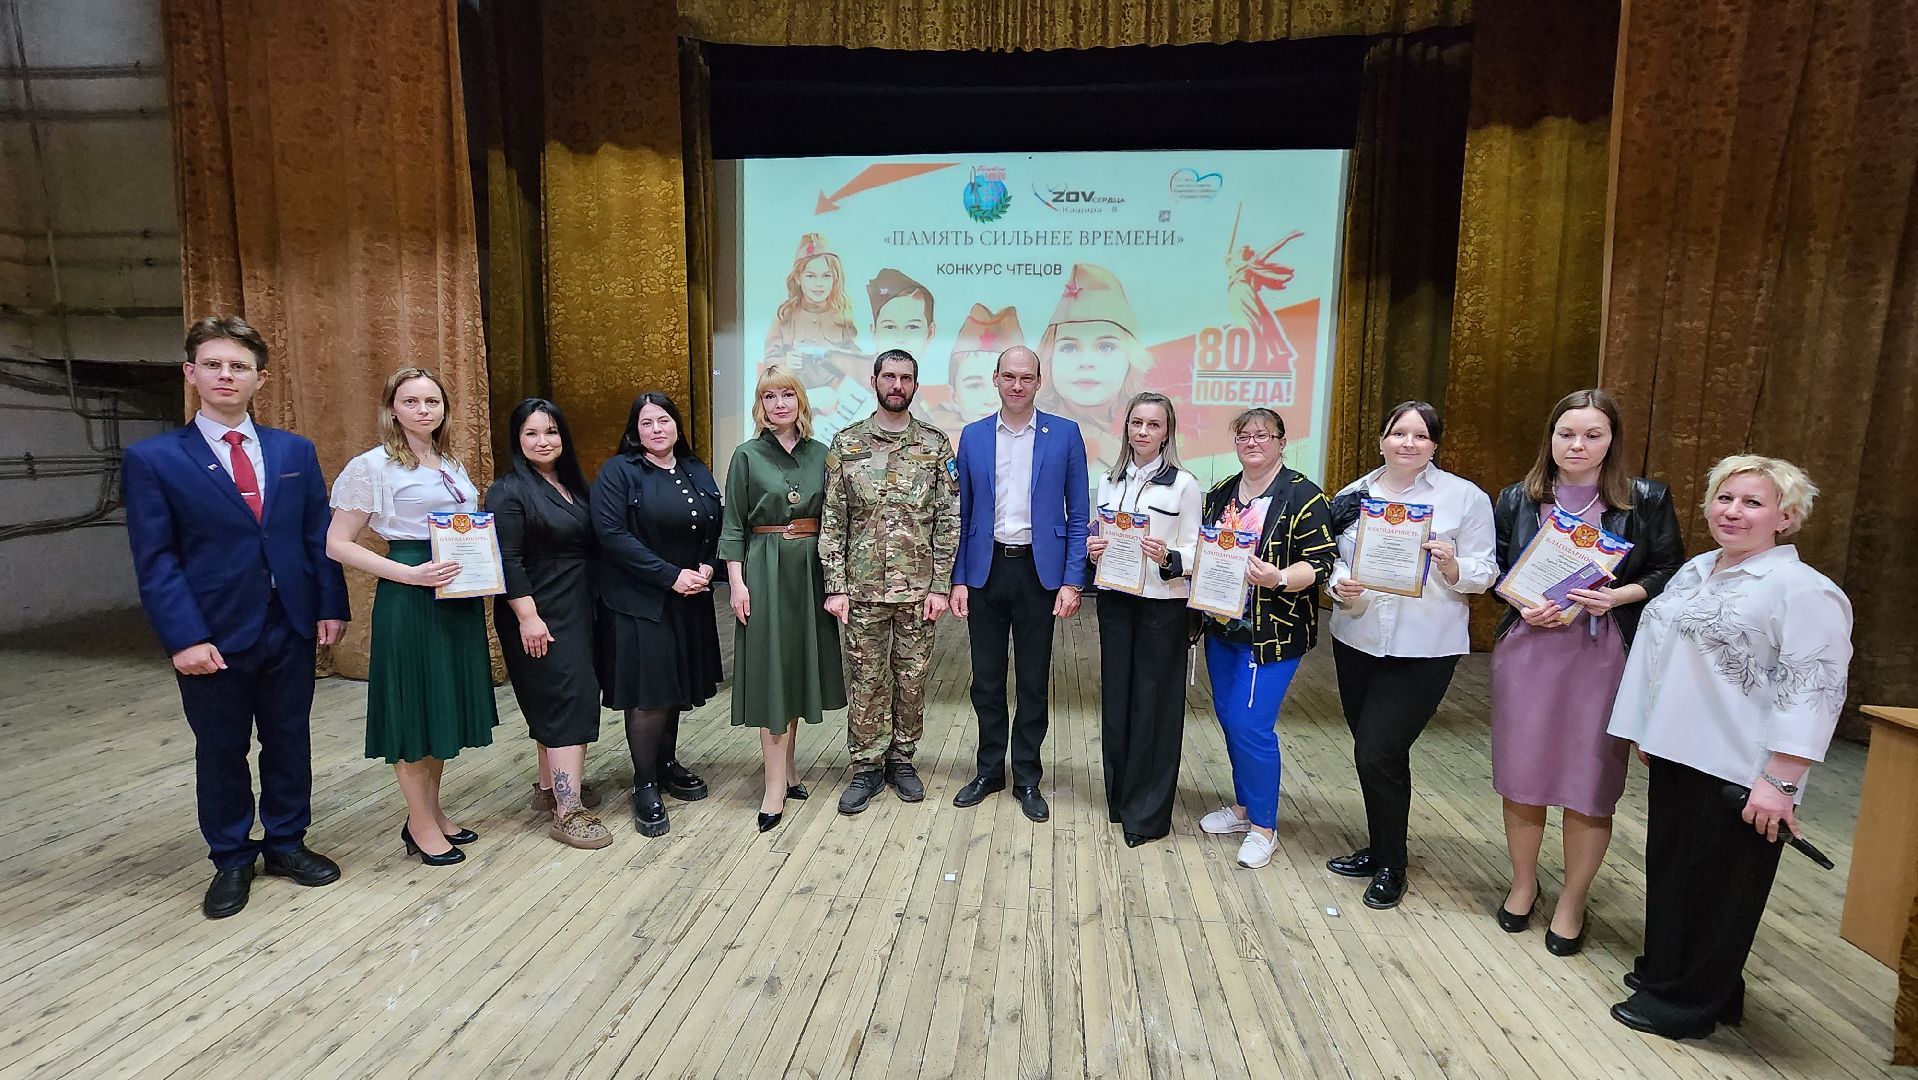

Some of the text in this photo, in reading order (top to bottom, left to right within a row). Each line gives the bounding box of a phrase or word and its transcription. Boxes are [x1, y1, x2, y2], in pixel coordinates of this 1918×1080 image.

[1052, 190, 1095, 202] ZOV
[884, 230, 1184, 246] «ПАМЯТЬ СИЛЬНЕЕ ВРЕМЕНИ»
[937, 263, 1062, 277] КОНКУРС ЧТЕЦОВ
[1198, 327, 1250, 371] 80
[1195, 380, 1292, 406] ПОБЕДА!
[1545, 536, 1595, 563] БЛАГОДАРНОС
